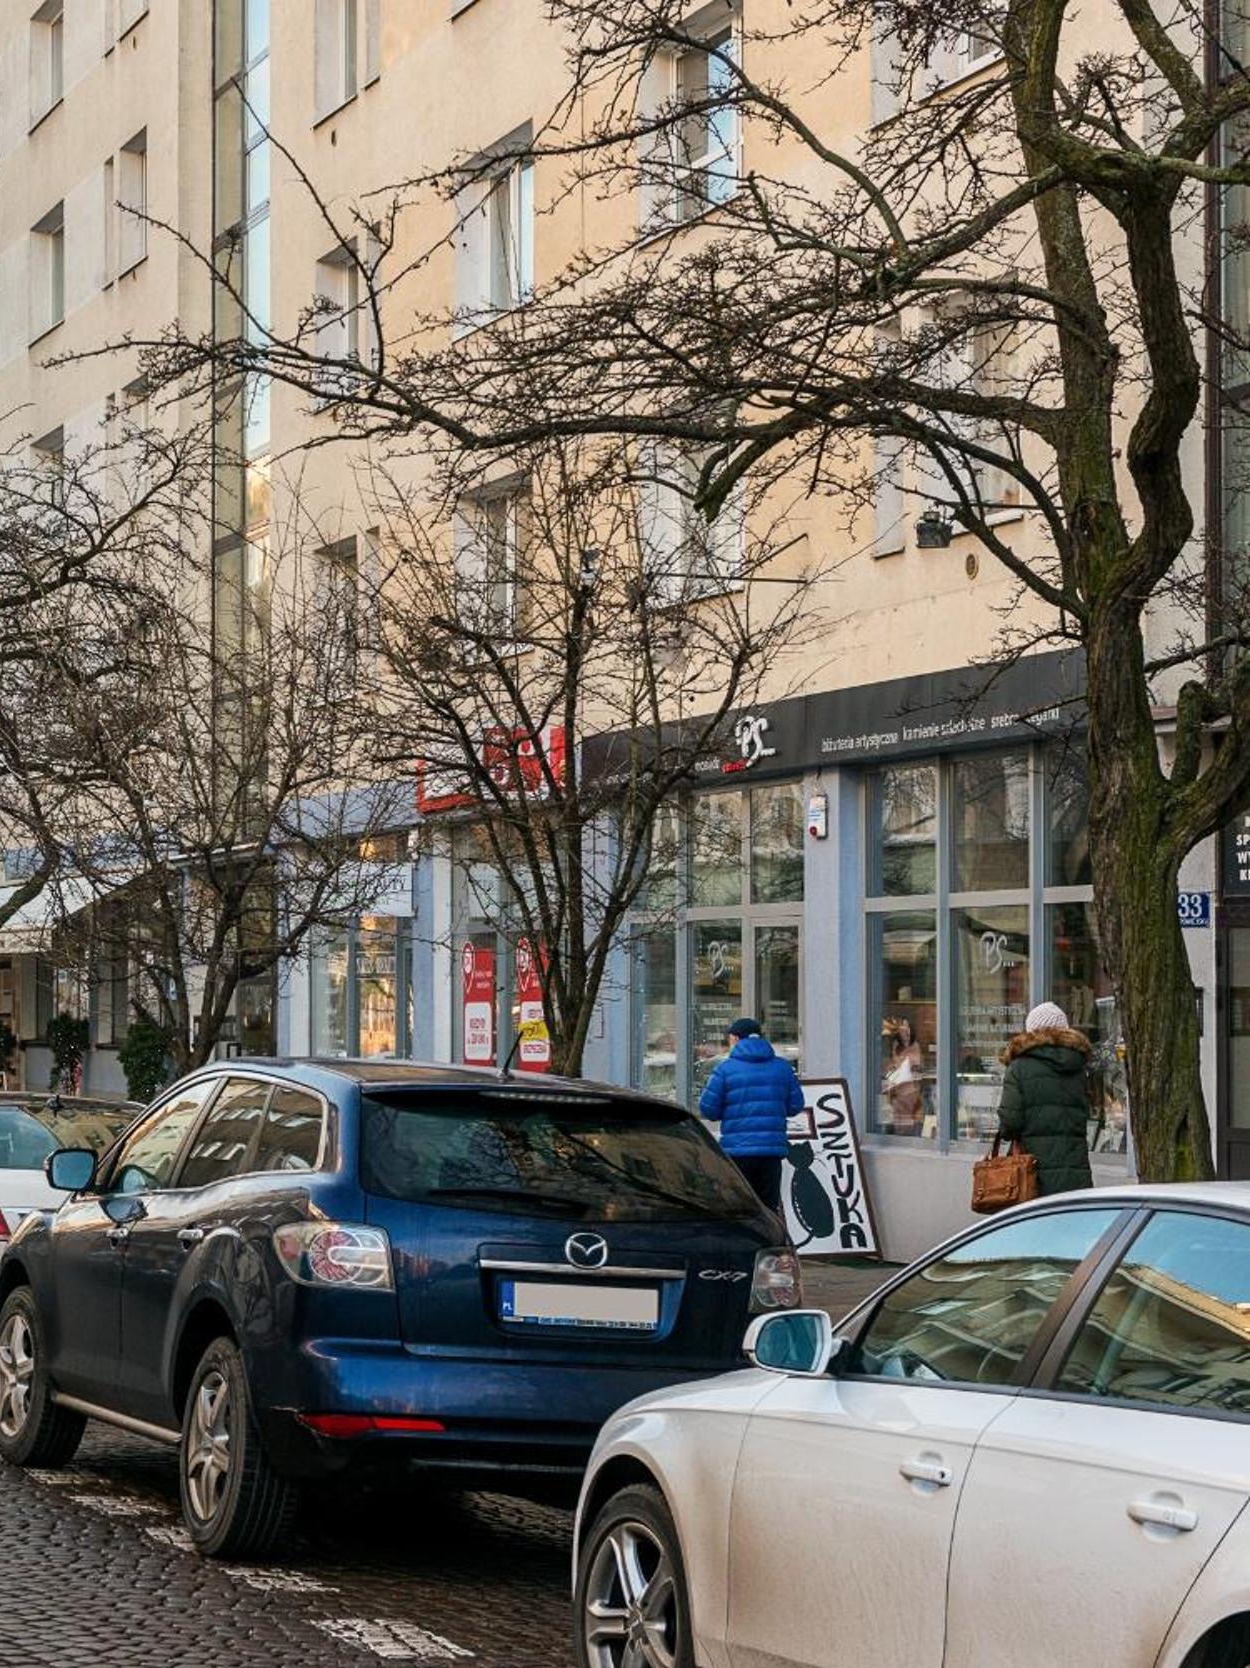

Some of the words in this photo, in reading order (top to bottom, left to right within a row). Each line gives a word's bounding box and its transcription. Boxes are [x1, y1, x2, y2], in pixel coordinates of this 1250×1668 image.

[1177, 894, 1202, 918] 33
[816, 1093, 867, 1249] SZTUKA
[502, 1302, 513, 1311] PL
